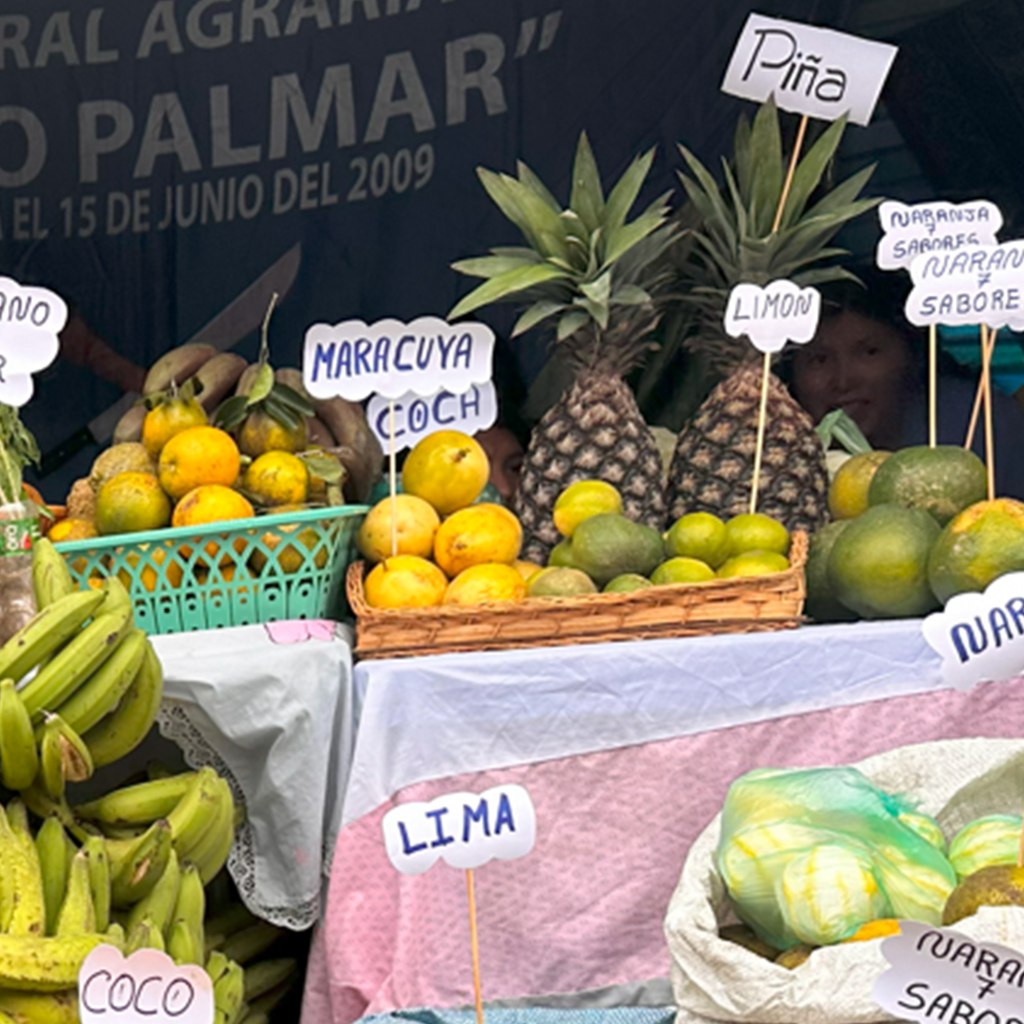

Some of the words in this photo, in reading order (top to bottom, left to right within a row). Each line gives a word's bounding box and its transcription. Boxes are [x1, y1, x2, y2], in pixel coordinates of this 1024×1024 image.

[741, 29, 847, 102] Piña
[17, 197, 49, 240] EL
[60, 193, 97, 238] 15
[107, 189, 151, 234] DE
[157, 175, 263, 231] JUNIO
[273, 161, 339, 215] DEL
[347, 143, 436, 203] 2009
[890, 206, 989, 228] NARANJA
[733, 293, 813, 320] LIMON
[919, 288, 1020, 316] SABORE
[311, 332, 473, 383] MARACUYA
[398, 793, 516, 856] LIMA
[916, 930, 1024, 988] NARA
[82, 969, 195, 1017] COCO
